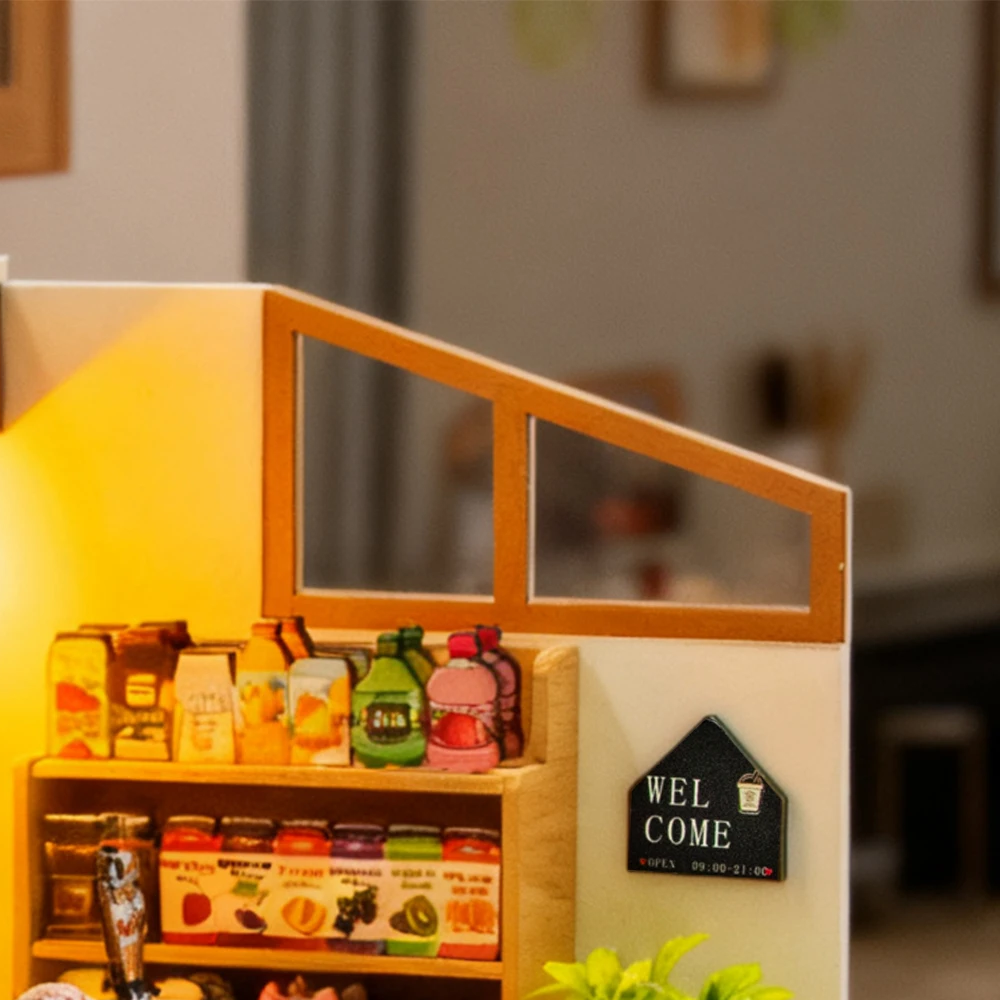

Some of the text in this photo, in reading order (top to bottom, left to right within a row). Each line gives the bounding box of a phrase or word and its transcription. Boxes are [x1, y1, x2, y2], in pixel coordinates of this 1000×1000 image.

[646, 775, 710, 808] WEL
[644, 814, 732, 849] COME
[647, 857, 676, 869] OPEN
